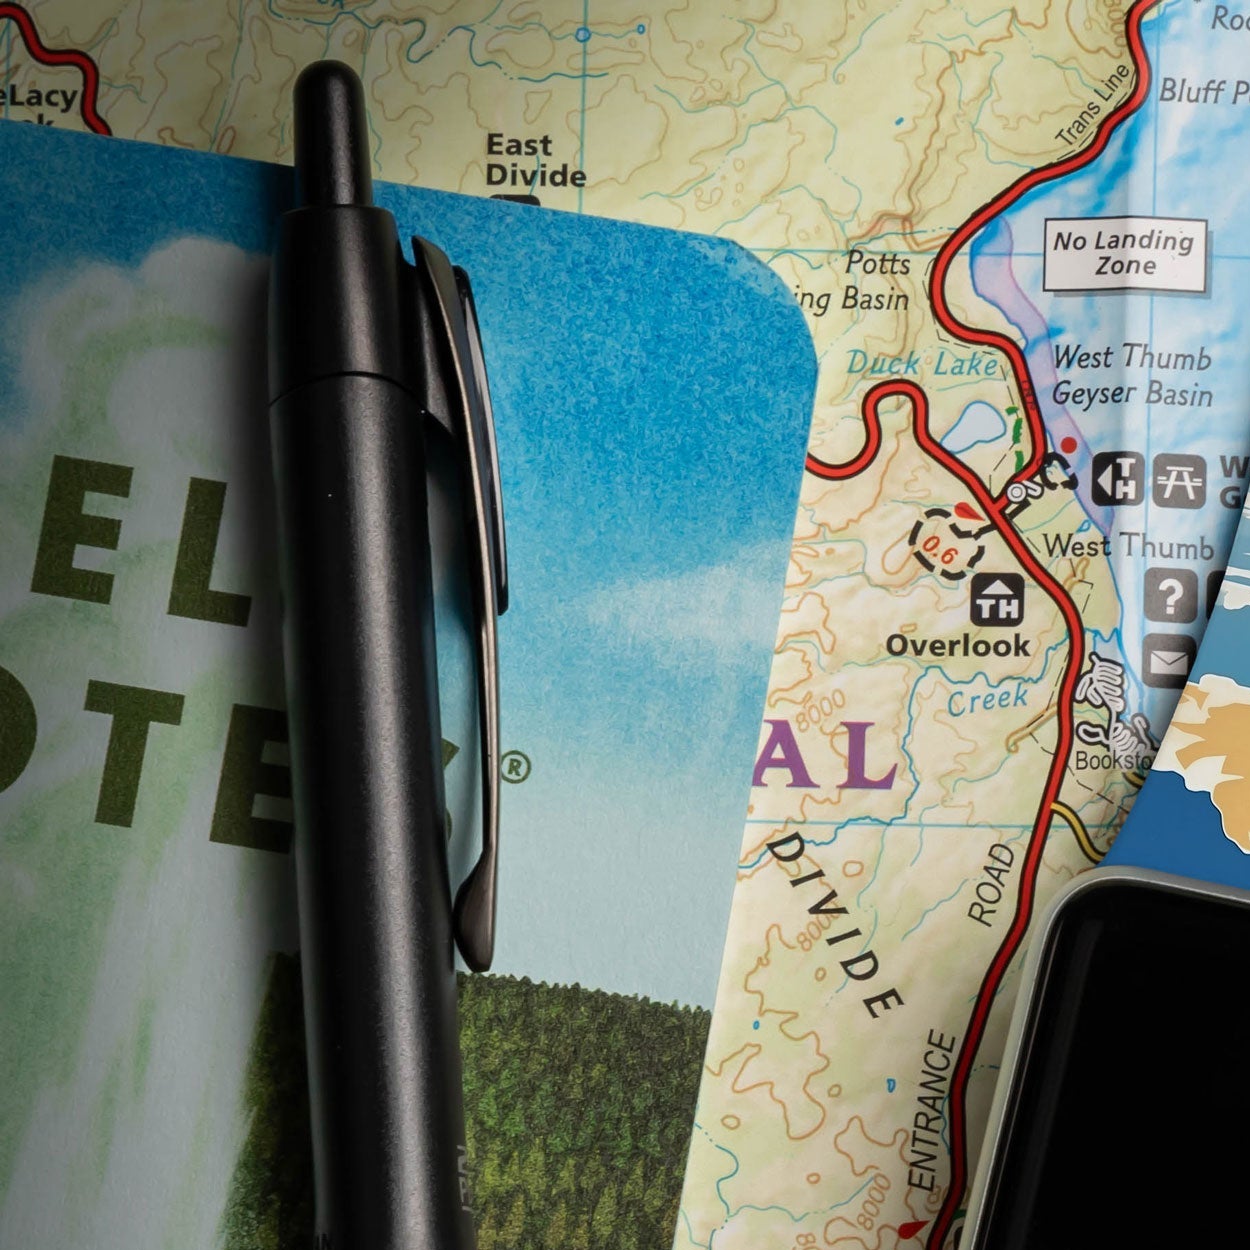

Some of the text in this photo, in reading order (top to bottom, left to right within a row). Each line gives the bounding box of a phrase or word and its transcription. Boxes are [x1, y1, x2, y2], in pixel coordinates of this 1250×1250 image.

[1054, 61, 1131, 149] Trans Line
[1159, 77, 1225, 105] Bluff
[486, 132, 553, 157] East
[485, 162, 588, 189] Divide
[1053, 229, 1194, 256] No Landing
[845, 250, 911, 277] Potts
[1094, 255, 1157, 276] Zone
[841, 286, 910, 312] Basin
[847, 349, 998, 378] Duck Lake
[1053, 343, 1213, 372] West Thumb
[1052, 380, 1214, 408] Geyser Basin
[1042, 532, 1215, 562] West Thumb
[886, 633, 1030, 659] Overlook
[948, 683, 1028, 718] Creek
[968, 841, 1016, 927] ROAD
[766, 832, 905, 1019] DIVIDE
[908, 1027, 956, 1193] ENTRANCE
